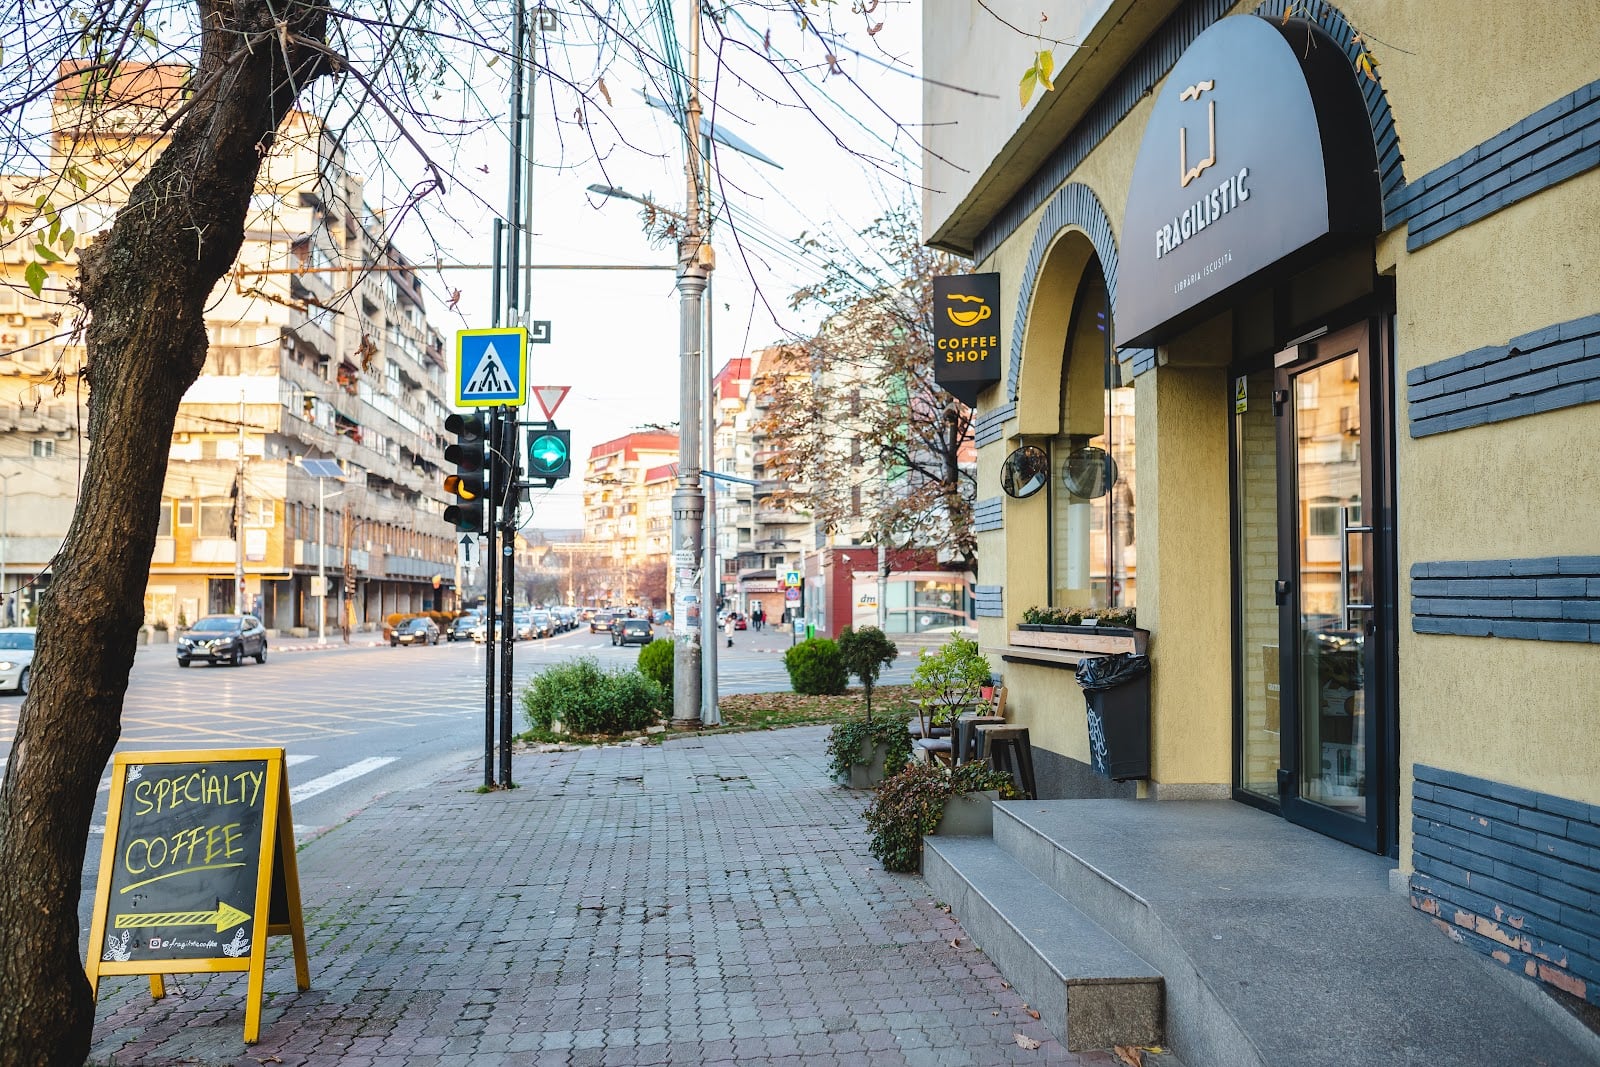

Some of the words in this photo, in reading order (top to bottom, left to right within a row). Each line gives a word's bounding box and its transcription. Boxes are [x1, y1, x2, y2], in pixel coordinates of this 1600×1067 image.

[1156, 167, 1251, 259] FRAGILISTIC
[937, 335, 997, 350] COFFEE
[946, 350, 988, 363] SHOP
[125, 823, 244, 875] COFFEE
